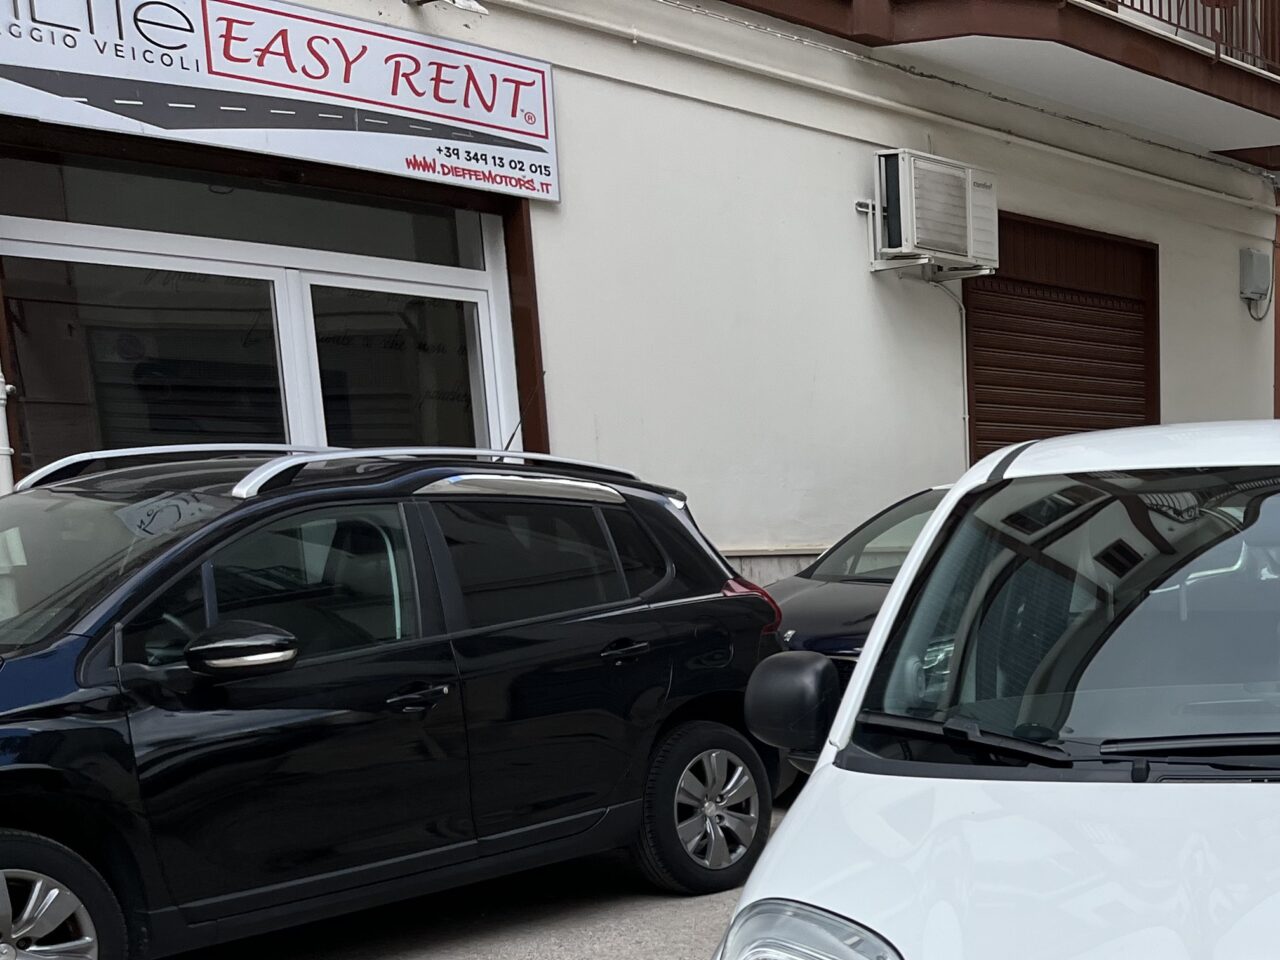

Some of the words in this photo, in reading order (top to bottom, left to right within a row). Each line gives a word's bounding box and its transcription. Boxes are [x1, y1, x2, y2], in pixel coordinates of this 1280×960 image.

[0, 23, 77, 49] GGIO
[94, 39, 200, 73] VEICOLI
[216, 16, 368, 84] EASY
[384, 53, 536, 118] RENT
[436, 146, 460, 160] +39
[464, 150, 488, 165] 349
[491, 156, 505, 168] 13
[508, 159, 525, 171] 02
[529, 163, 551, 177] 015
